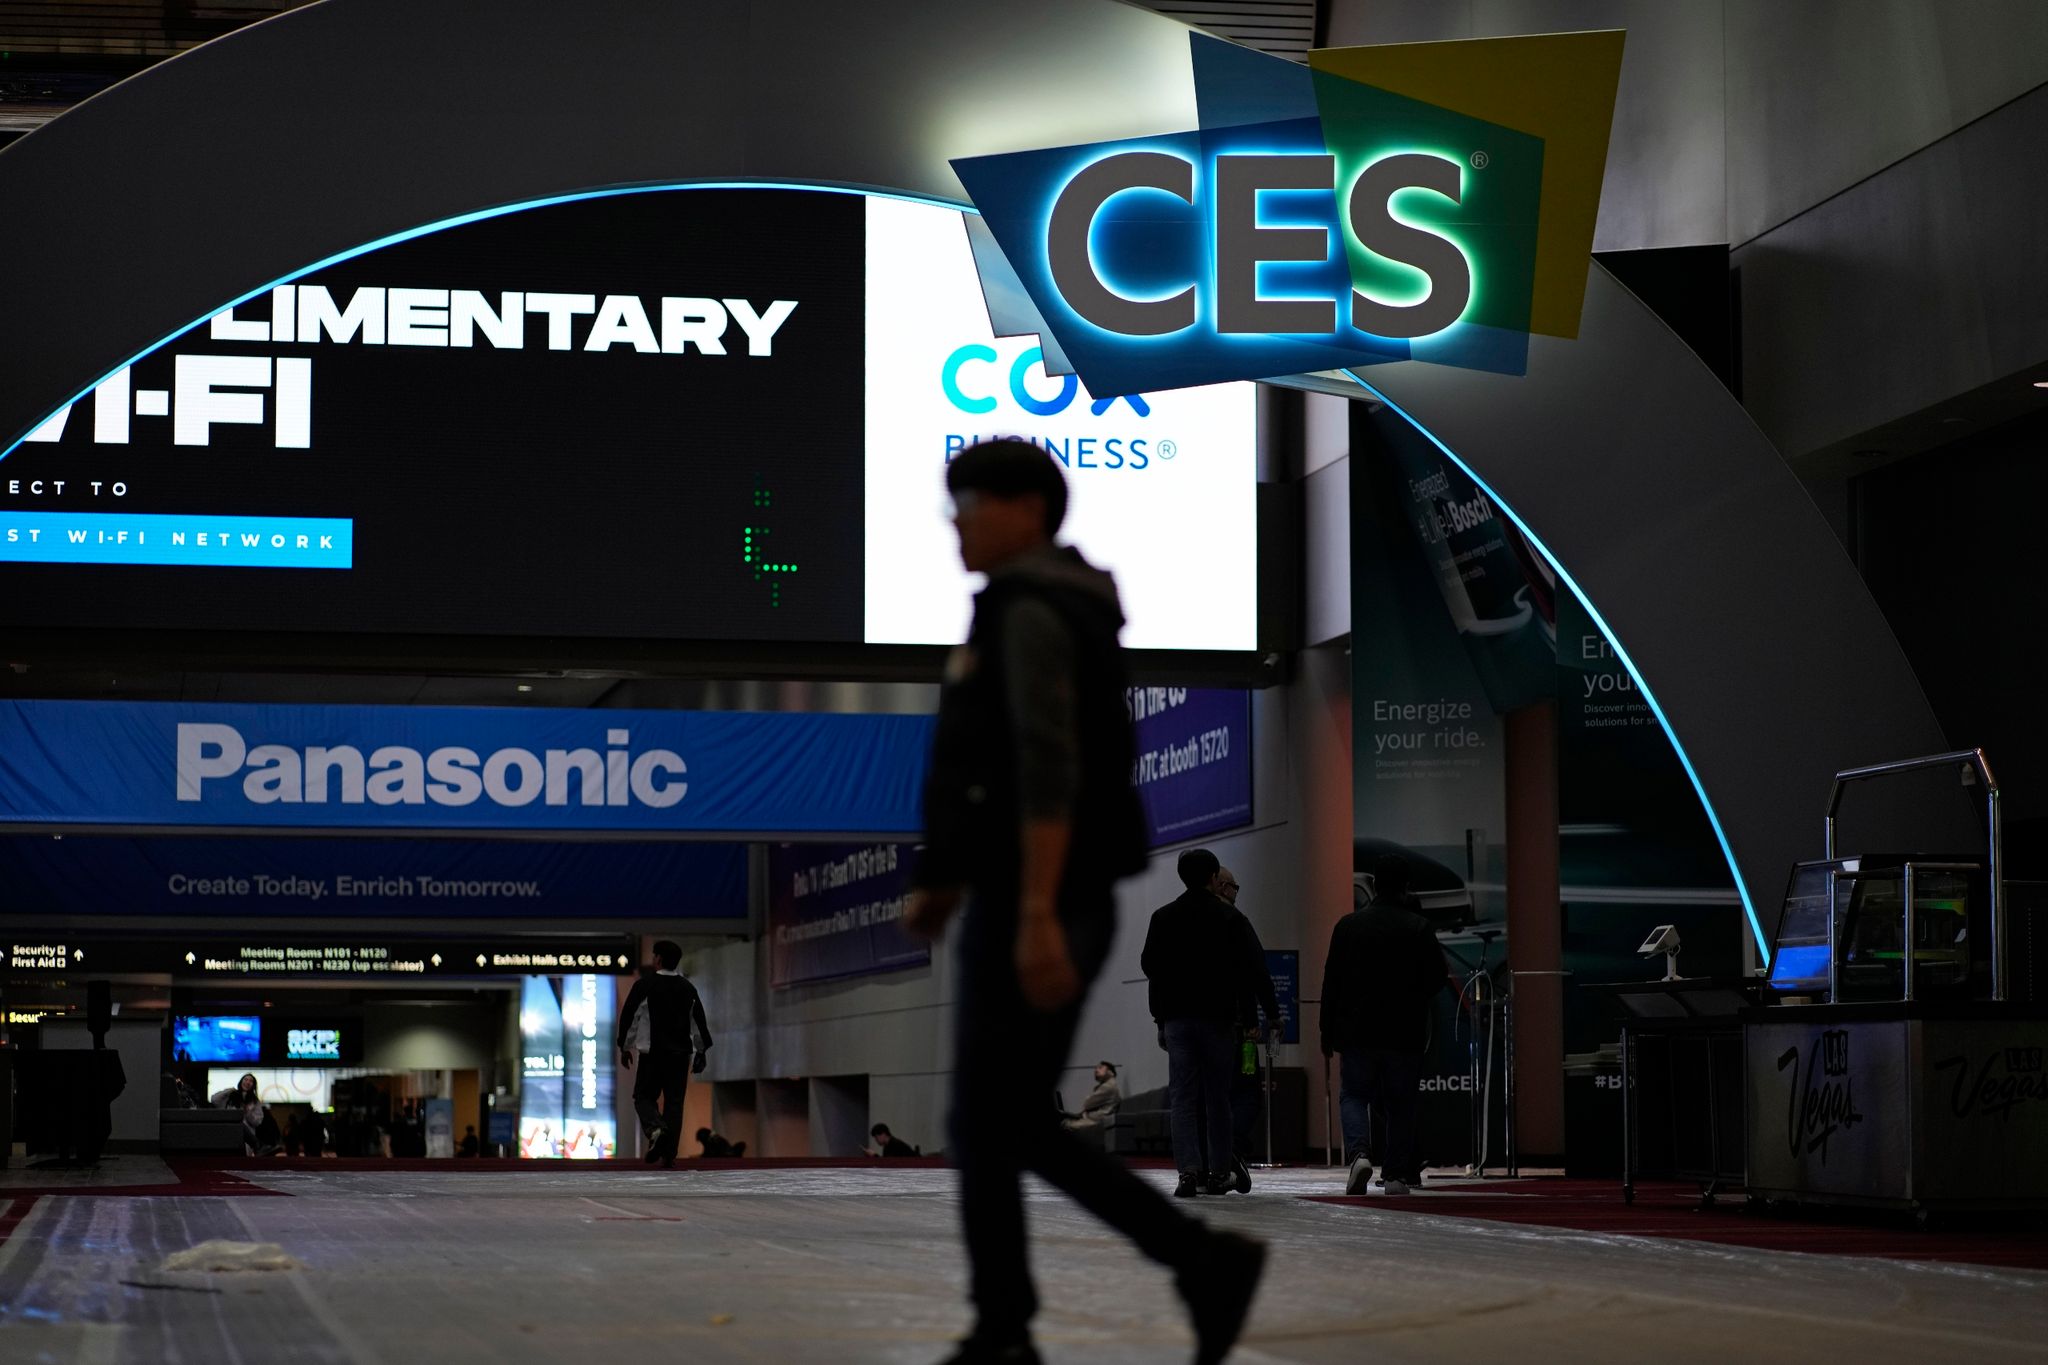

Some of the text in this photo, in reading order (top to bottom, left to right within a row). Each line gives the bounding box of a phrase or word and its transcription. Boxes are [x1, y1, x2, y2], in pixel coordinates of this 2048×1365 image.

[90, 481, 127, 497] TO
[6, 528, 334, 550] ST WI-FI NETWORK
[1583, 673, 1638, 698] you
[1373, 697, 1472, 724] Energize
[1584, 704, 1625, 714] Discover
[1584, 716, 1628, 728] solutions
[1630, 715, 1644, 726] for
[1374, 726, 1486, 755] your ride.
[1169, 735, 1199, 775] booth
[1199, 725, 1230, 766] 15720
[175, 721, 689, 809] Panasonic
[167, 873, 541, 900] Create Today. Enrich Tomorrow.
[12, 944, 57, 959] Security
[240, 947, 285, 961] Meeting
[286, 947, 323, 959] Rooms
[492, 953, 531, 967] Exhibit
[531, 953, 559, 967] Halls
[12, 957, 56, 969] First Aid
[204, 959, 249, 973] Meeting
[249, 959, 287, 971] Rooms
[352, 959, 371, 973] (up
[371, 959, 425, 973] escalator)
[8, 1010, 48, 1024] Secur
[1824, 1031, 1848, 1075] LAS
[1418, 1074, 1474, 1092] schCE
[1777, 1038, 1863, 1168] Vegas
